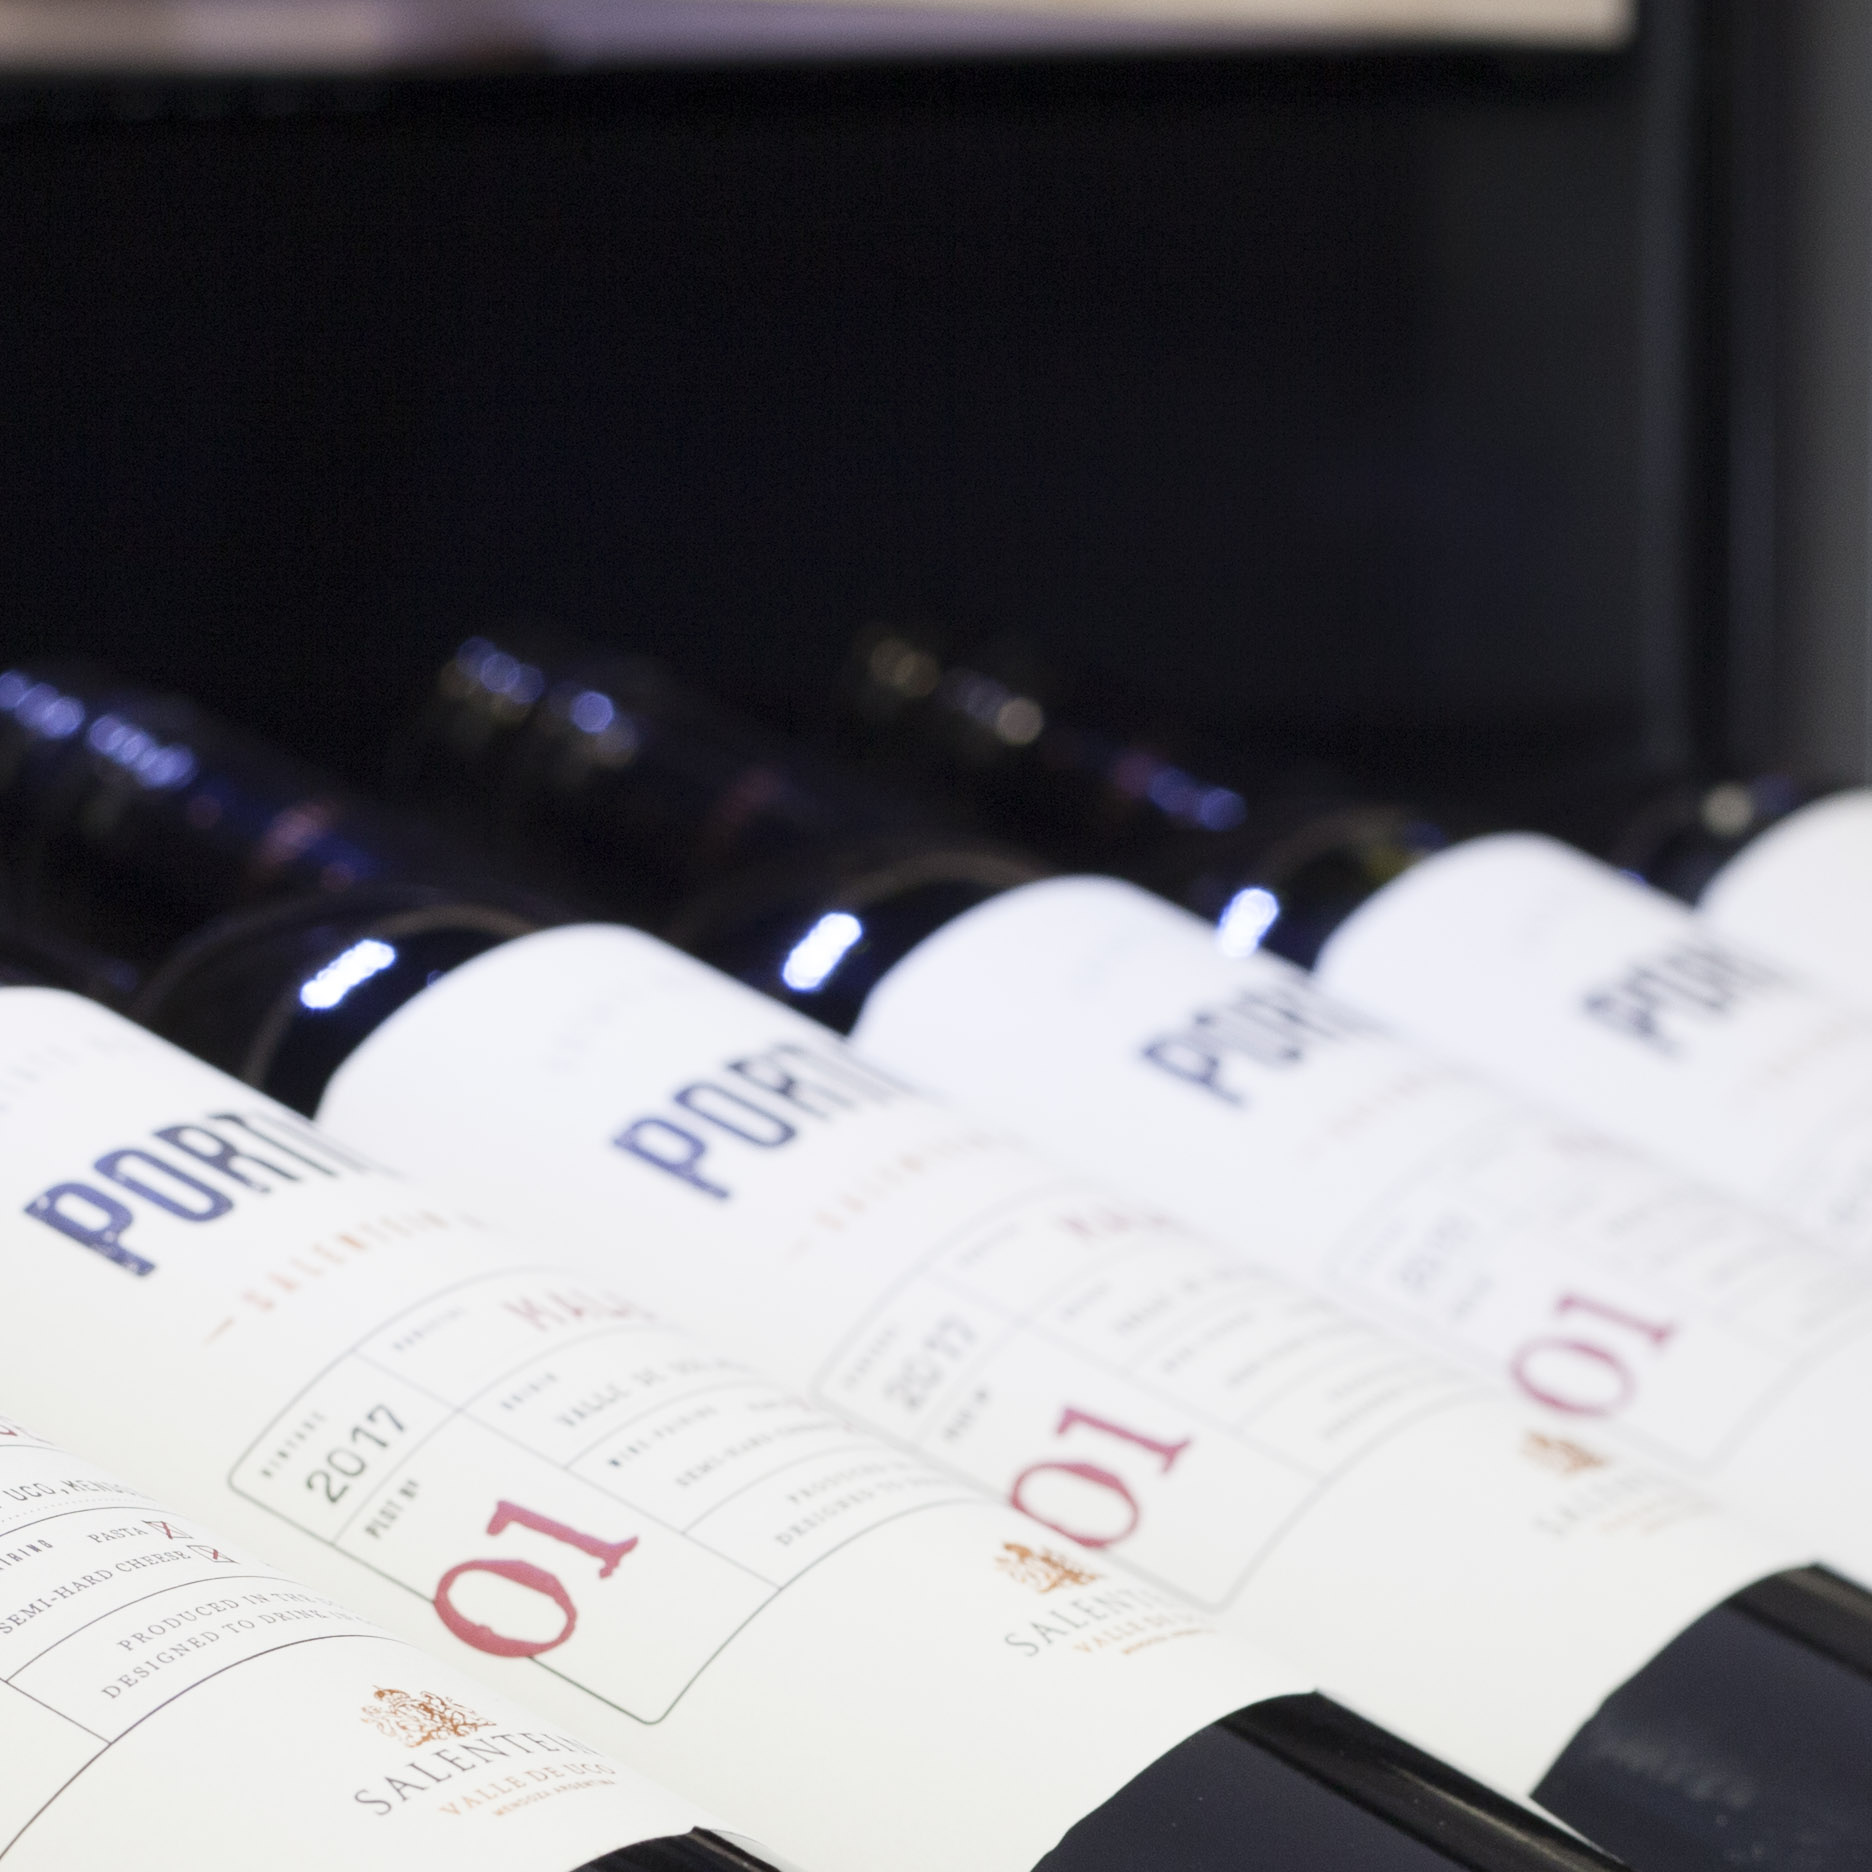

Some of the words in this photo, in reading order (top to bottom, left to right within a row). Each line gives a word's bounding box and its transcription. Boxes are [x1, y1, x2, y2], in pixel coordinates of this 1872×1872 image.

[1508, 1293, 1678, 1420] 01
[304, 1402, 408, 1506] 2017
[1008, 1405, 1194, 1551] 01
[87, 1525, 150, 1544] PASTA
[114, 1549, 193, 1574] CHEESE
[432, 1499, 640, 1658] 01
[100, 1630, 221, 1700] DESIGNED
[221, 1618, 257, 1635] TO
[116, 1598, 241, 1652] PRODUCED
[241, 1593, 271, 1607] IN
[437, 1775, 529, 1816] VALLE
[524, 1765, 566, 1783] DE
